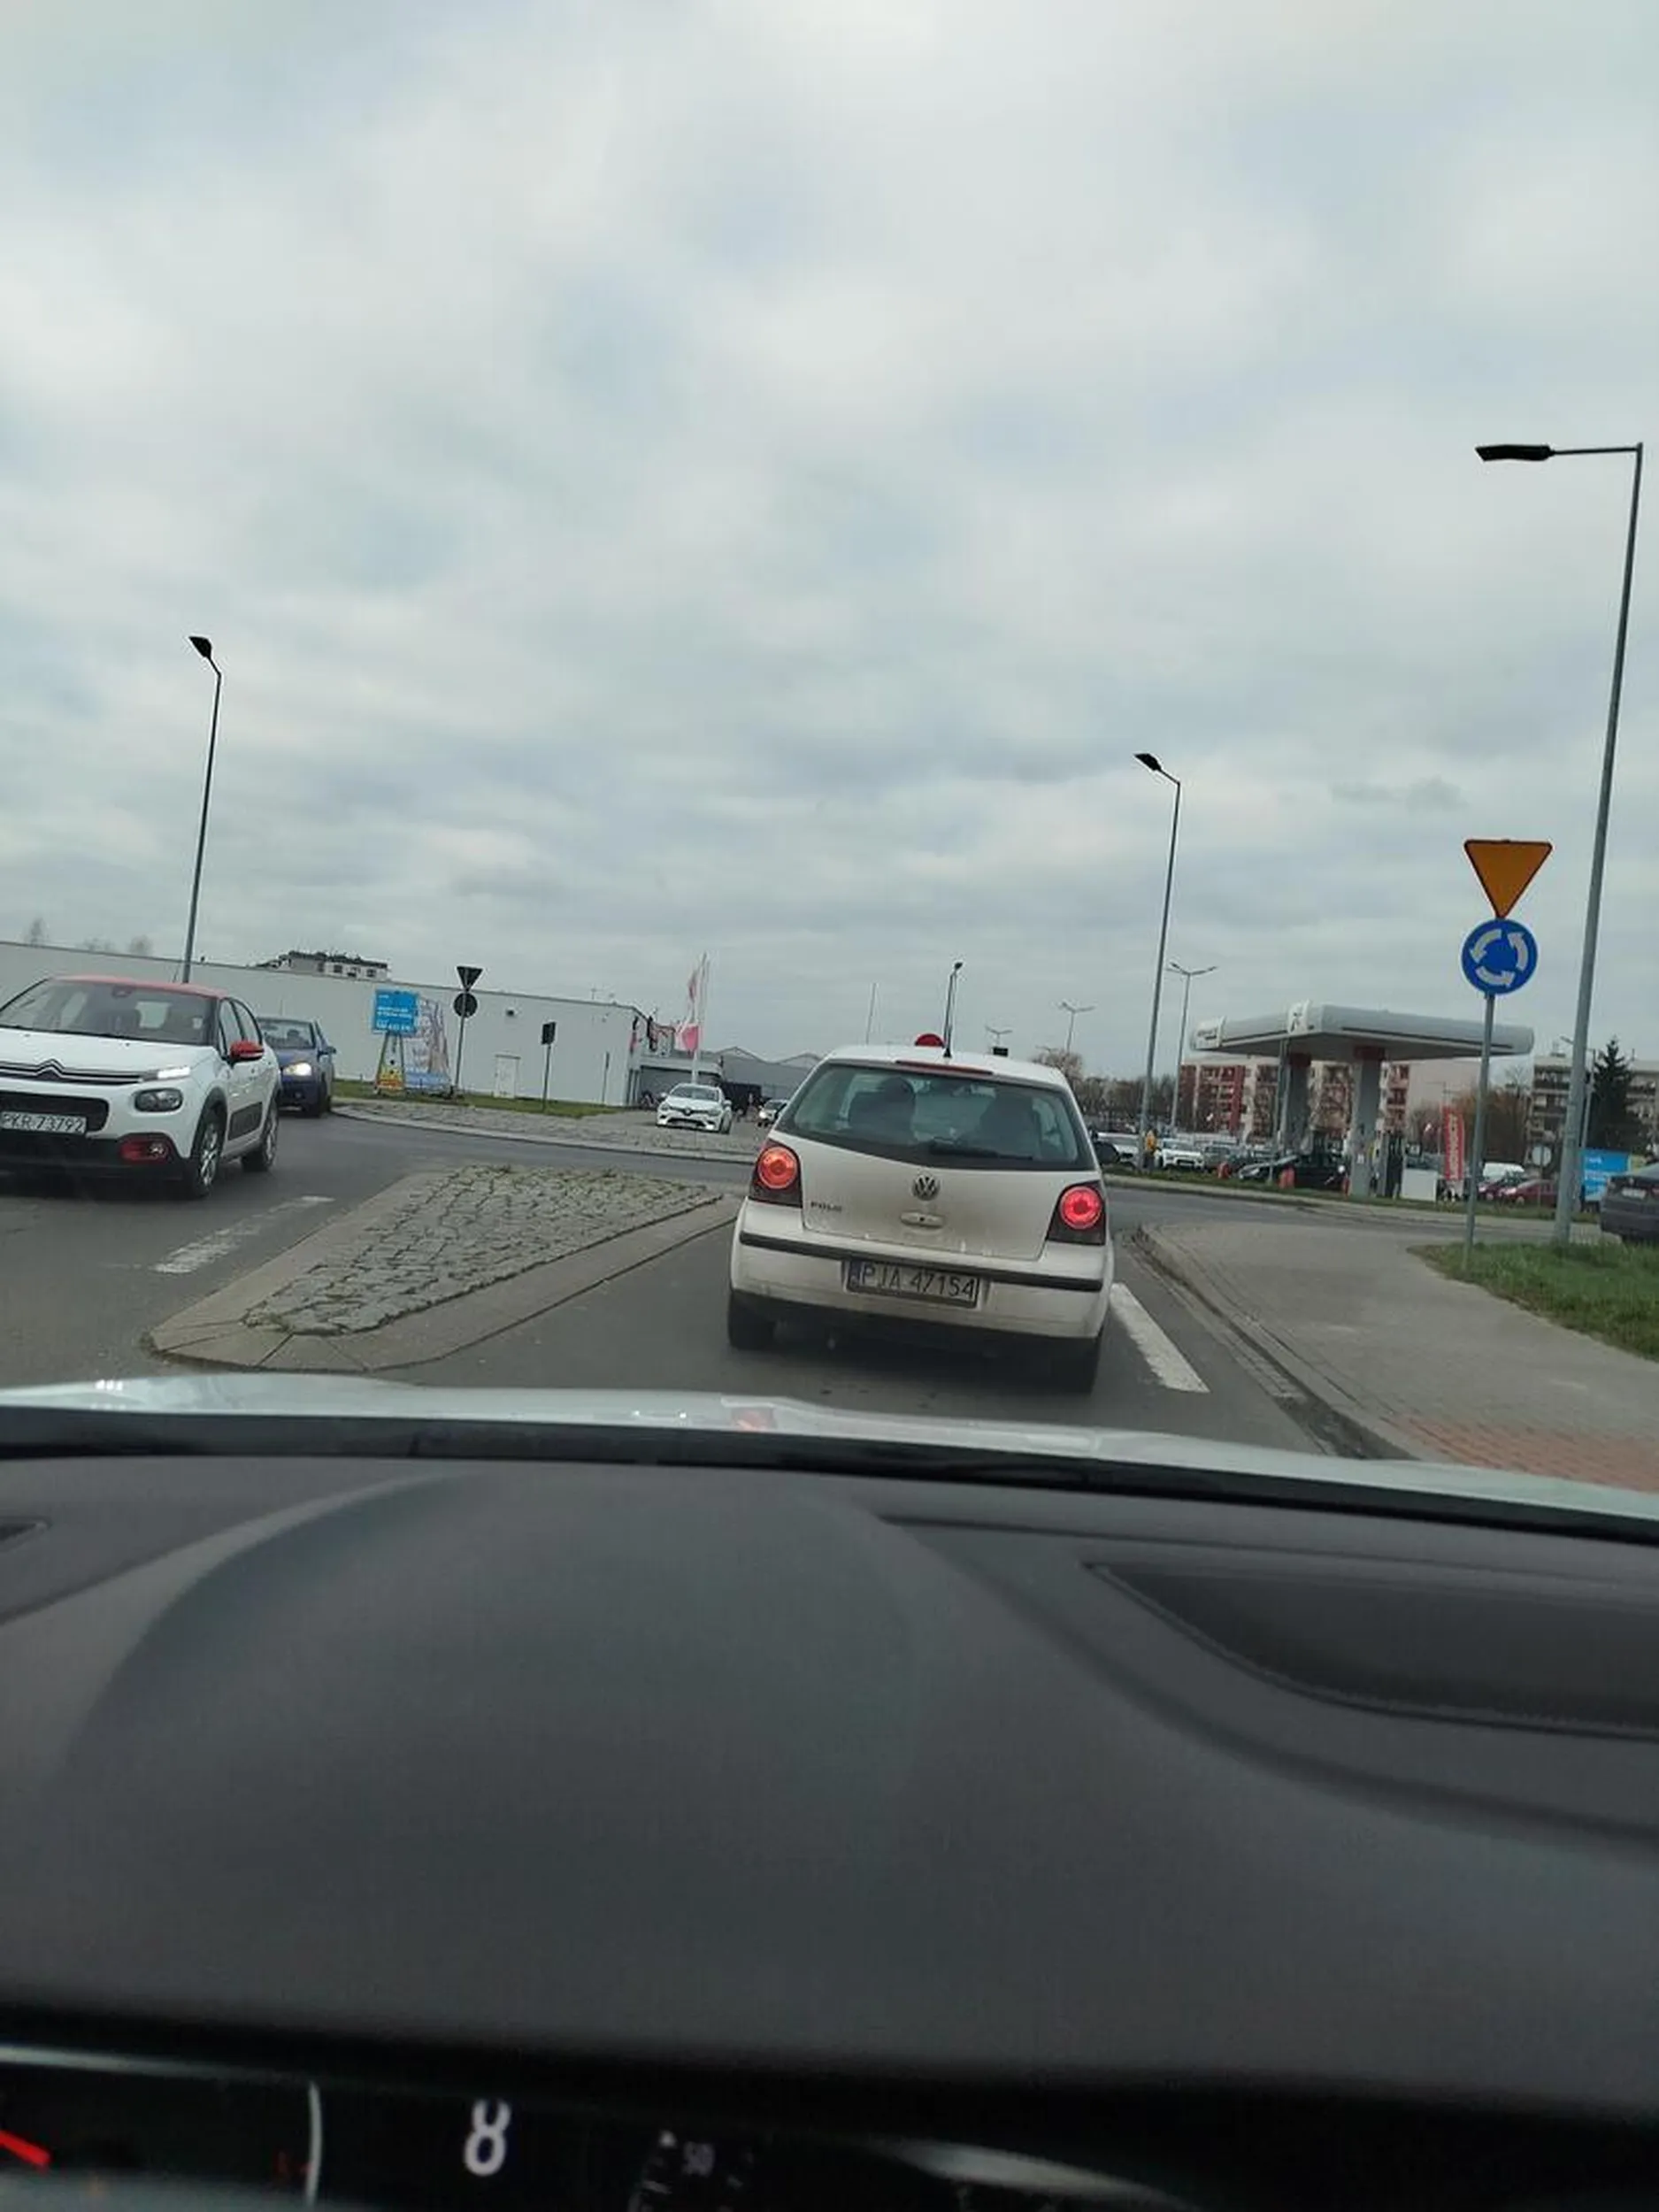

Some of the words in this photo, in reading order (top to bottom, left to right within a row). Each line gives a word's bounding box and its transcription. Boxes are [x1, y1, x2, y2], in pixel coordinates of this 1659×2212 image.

[861, 1262, 902, 1290] PJA
[909, 1269, 976, 1300] 47154
[464, 2099, 511, 2177] 8
